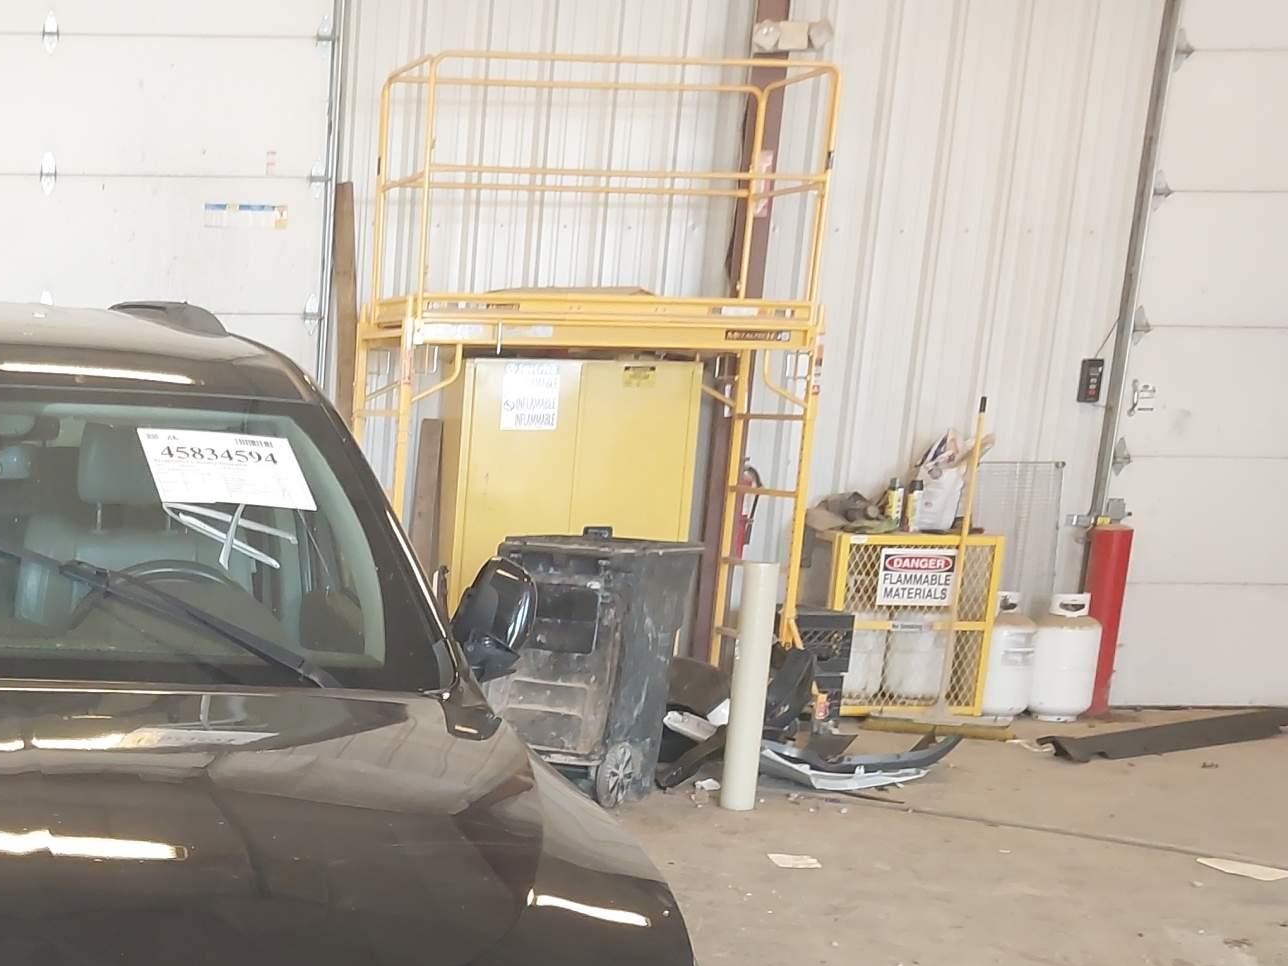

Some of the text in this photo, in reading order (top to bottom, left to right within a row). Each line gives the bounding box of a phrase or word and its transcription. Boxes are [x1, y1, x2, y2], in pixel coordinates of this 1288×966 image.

[160, 445, 278, 465] 45834594
[893, 557, 946, 569] DANGER
[883, 573, 951, 586] FLAMMABLE
[883, 587, 948, 600] MATERIALS
